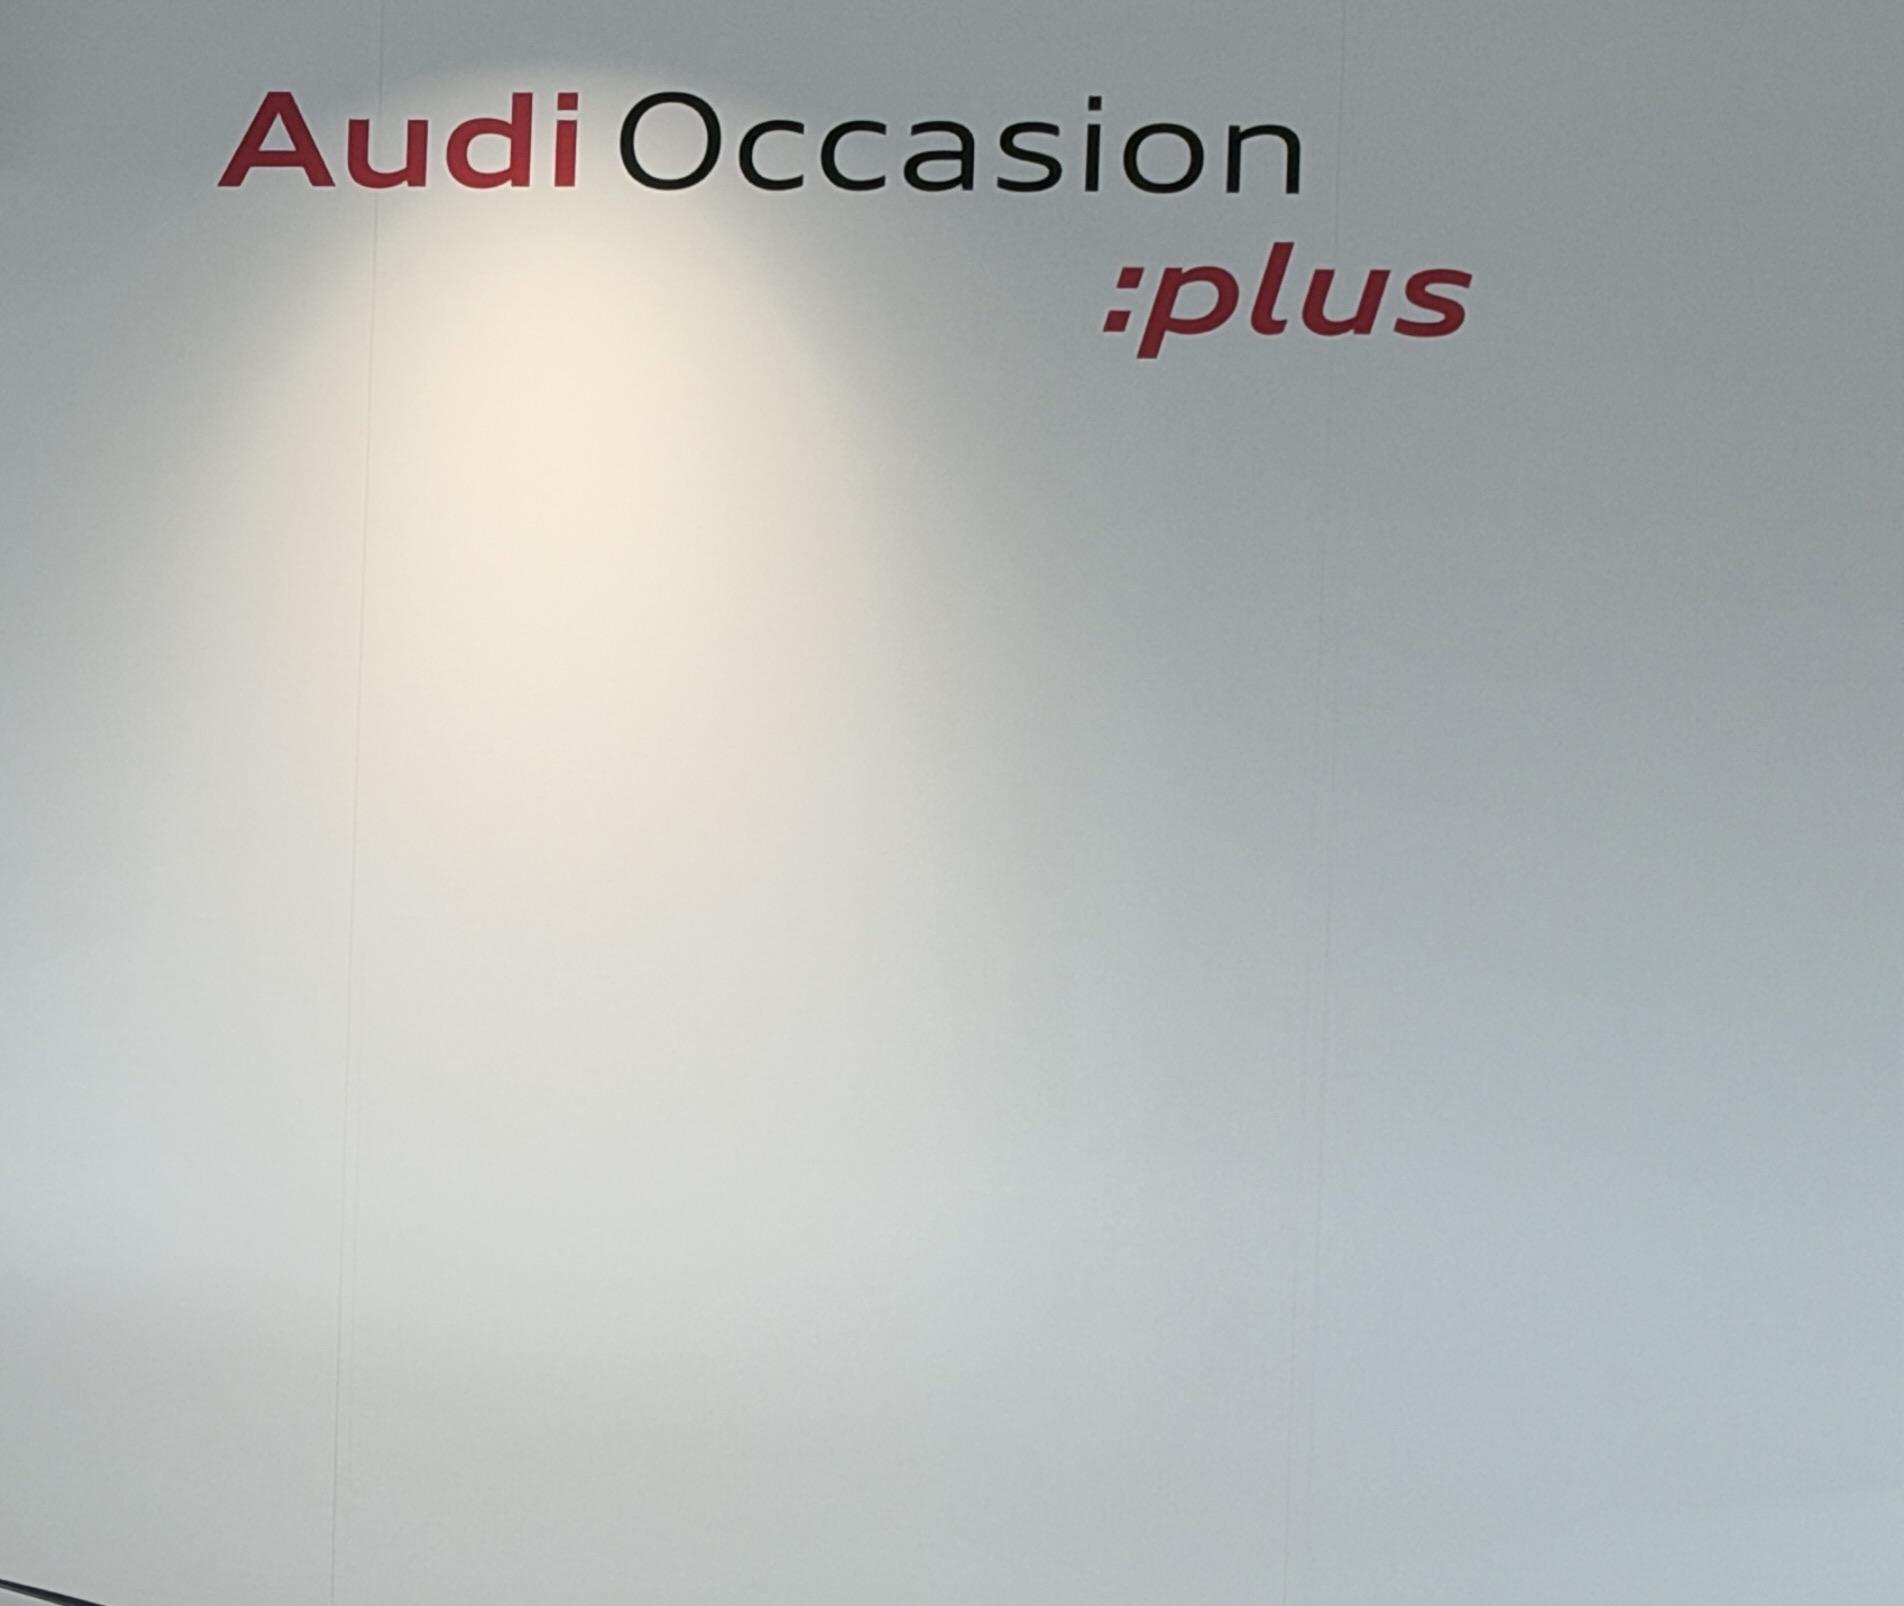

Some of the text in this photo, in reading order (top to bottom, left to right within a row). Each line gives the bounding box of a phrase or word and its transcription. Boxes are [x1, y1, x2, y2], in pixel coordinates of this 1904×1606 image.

[216, 91, 1303, 195] Audi Occasion
[1102, 242, 1473, 359] :plus
